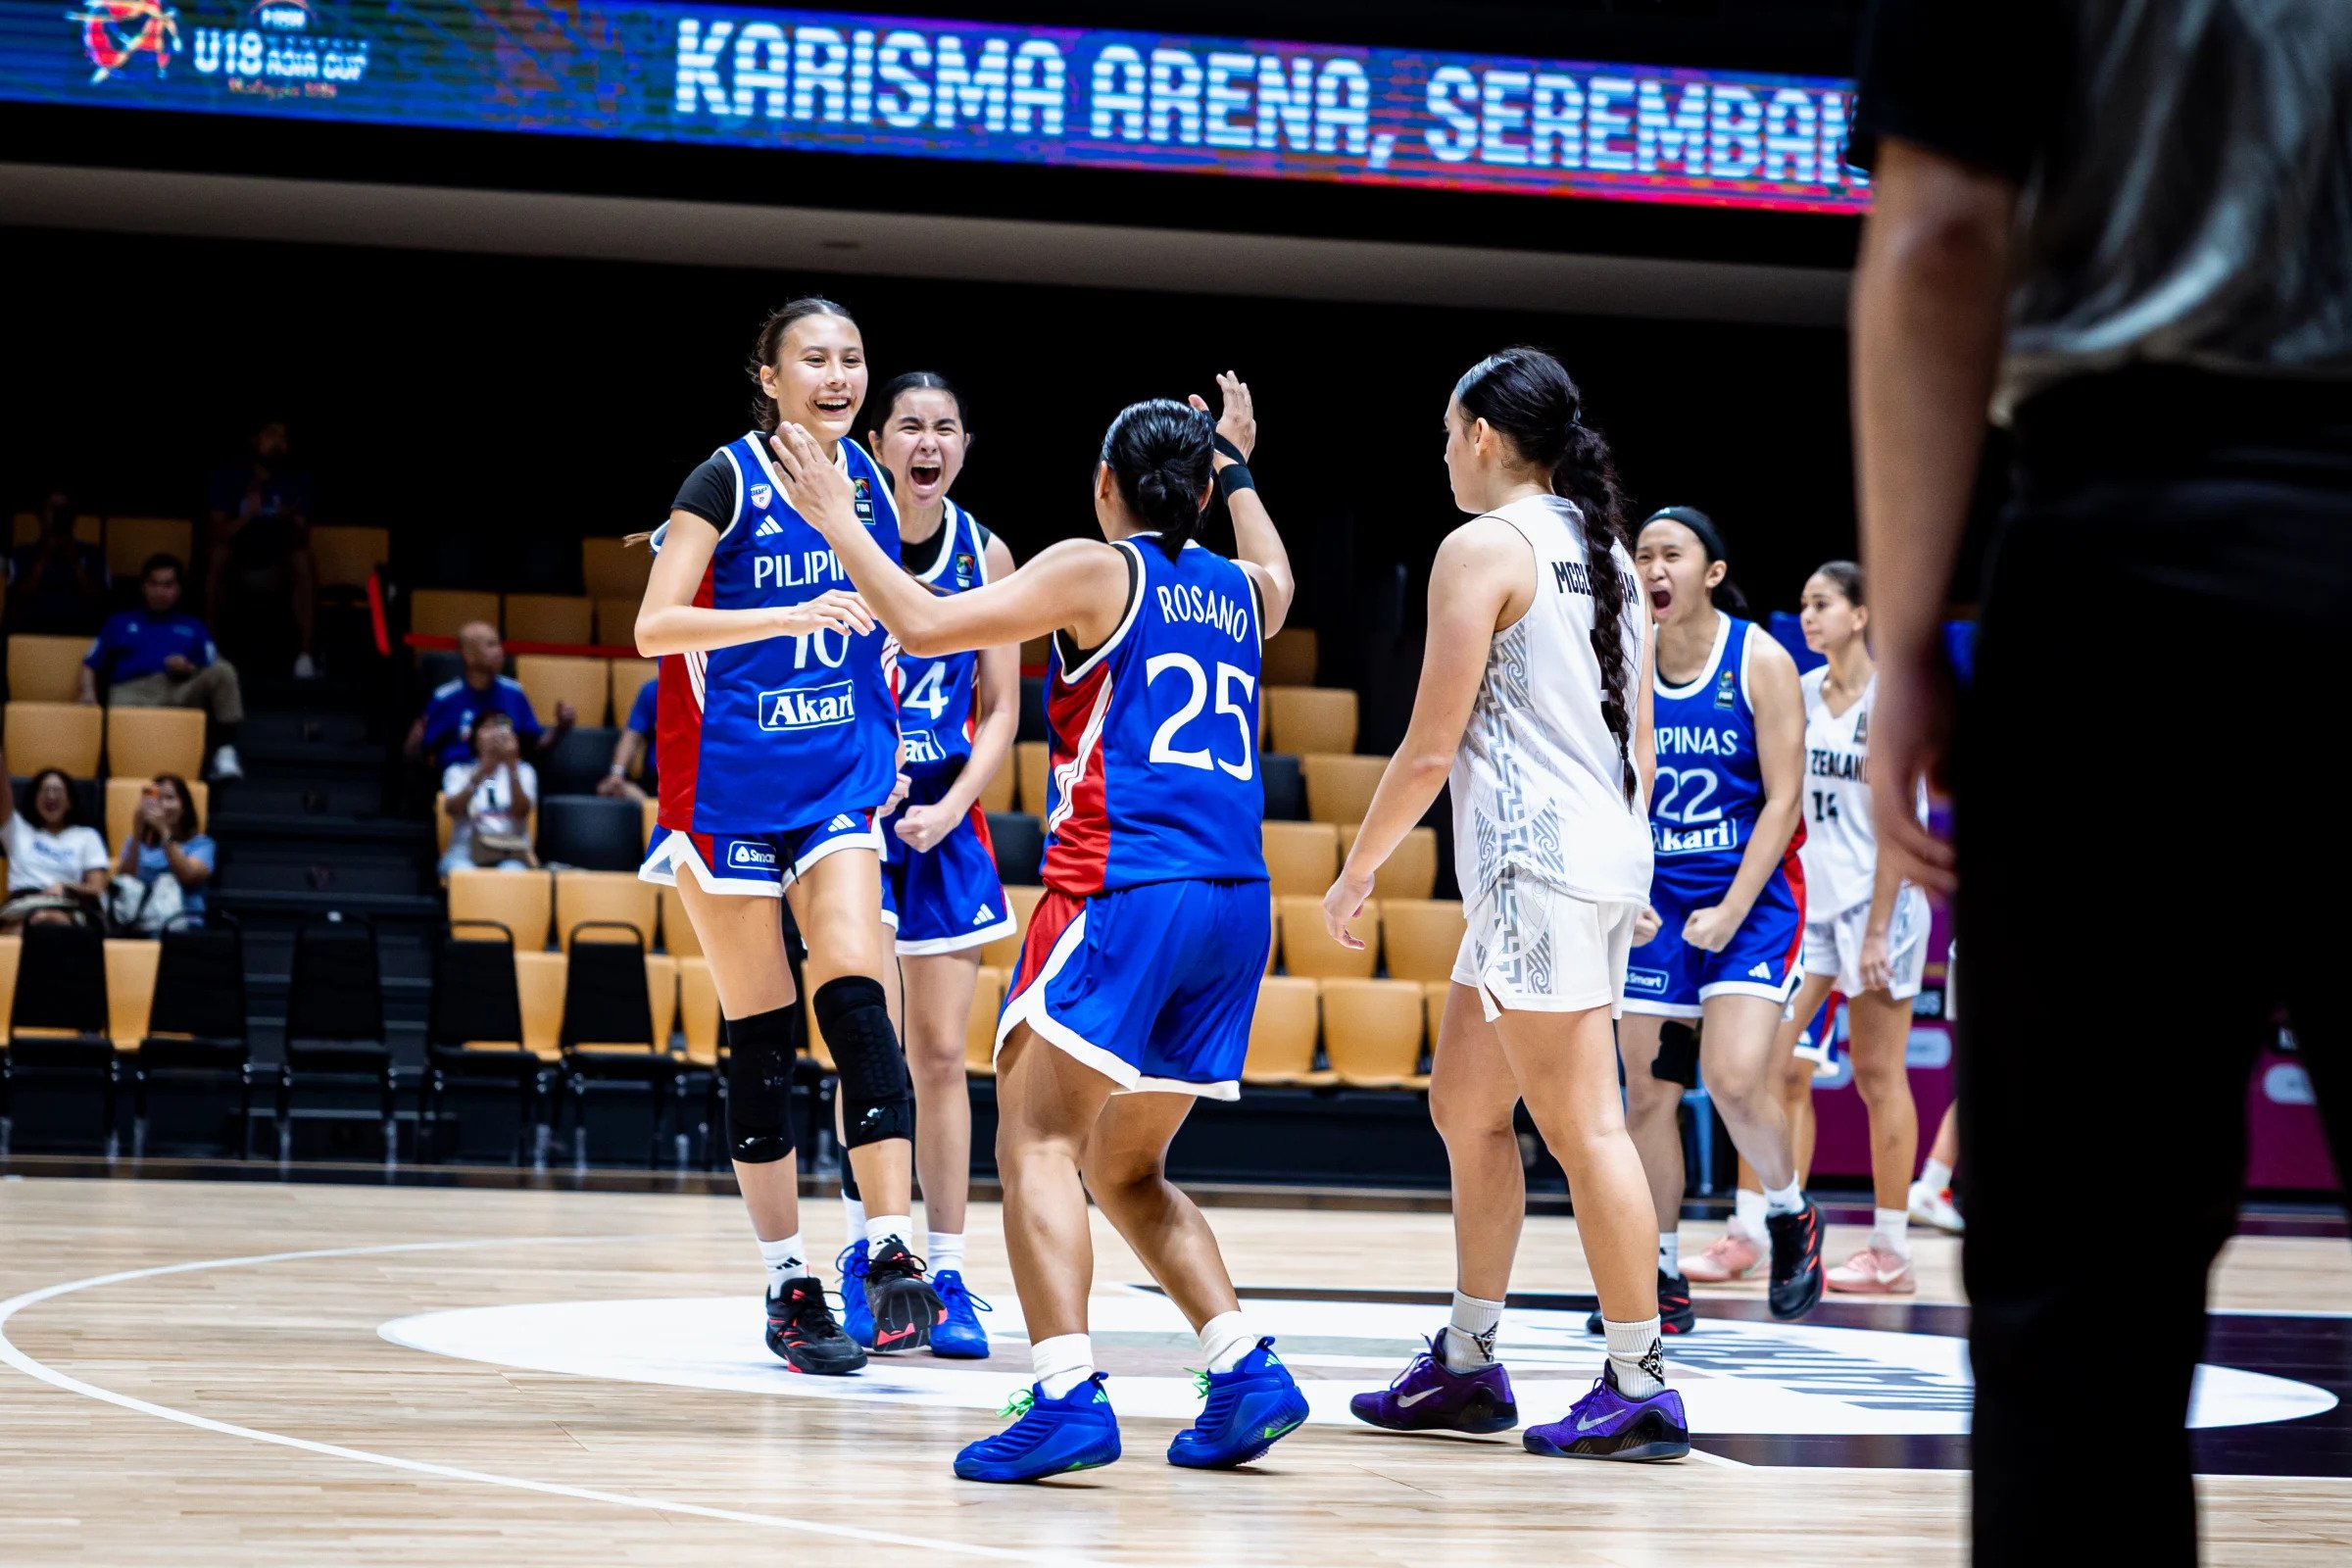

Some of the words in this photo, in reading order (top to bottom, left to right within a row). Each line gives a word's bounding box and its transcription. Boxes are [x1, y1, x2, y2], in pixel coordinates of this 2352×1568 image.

[194, 27, 263, 74] U18
[322, 53, 368, 80] CUP
[676, 19, 1065, 134] KARISMA
[1091, 45, 1395, 169] ARENA,
[754, 549, 845, 589] PILIPI
[1156, 583, 1248, 643] ROSANO
[767, 685, 855, 726] Akari
[1146, 652, 1255, 781] 25
[905, 734, 941, 762] ari
[1654, 726, 1739, 756] IPINAS
[1655, 766, 1723, 824] 22
[750, 849, 775, 863] Smar
